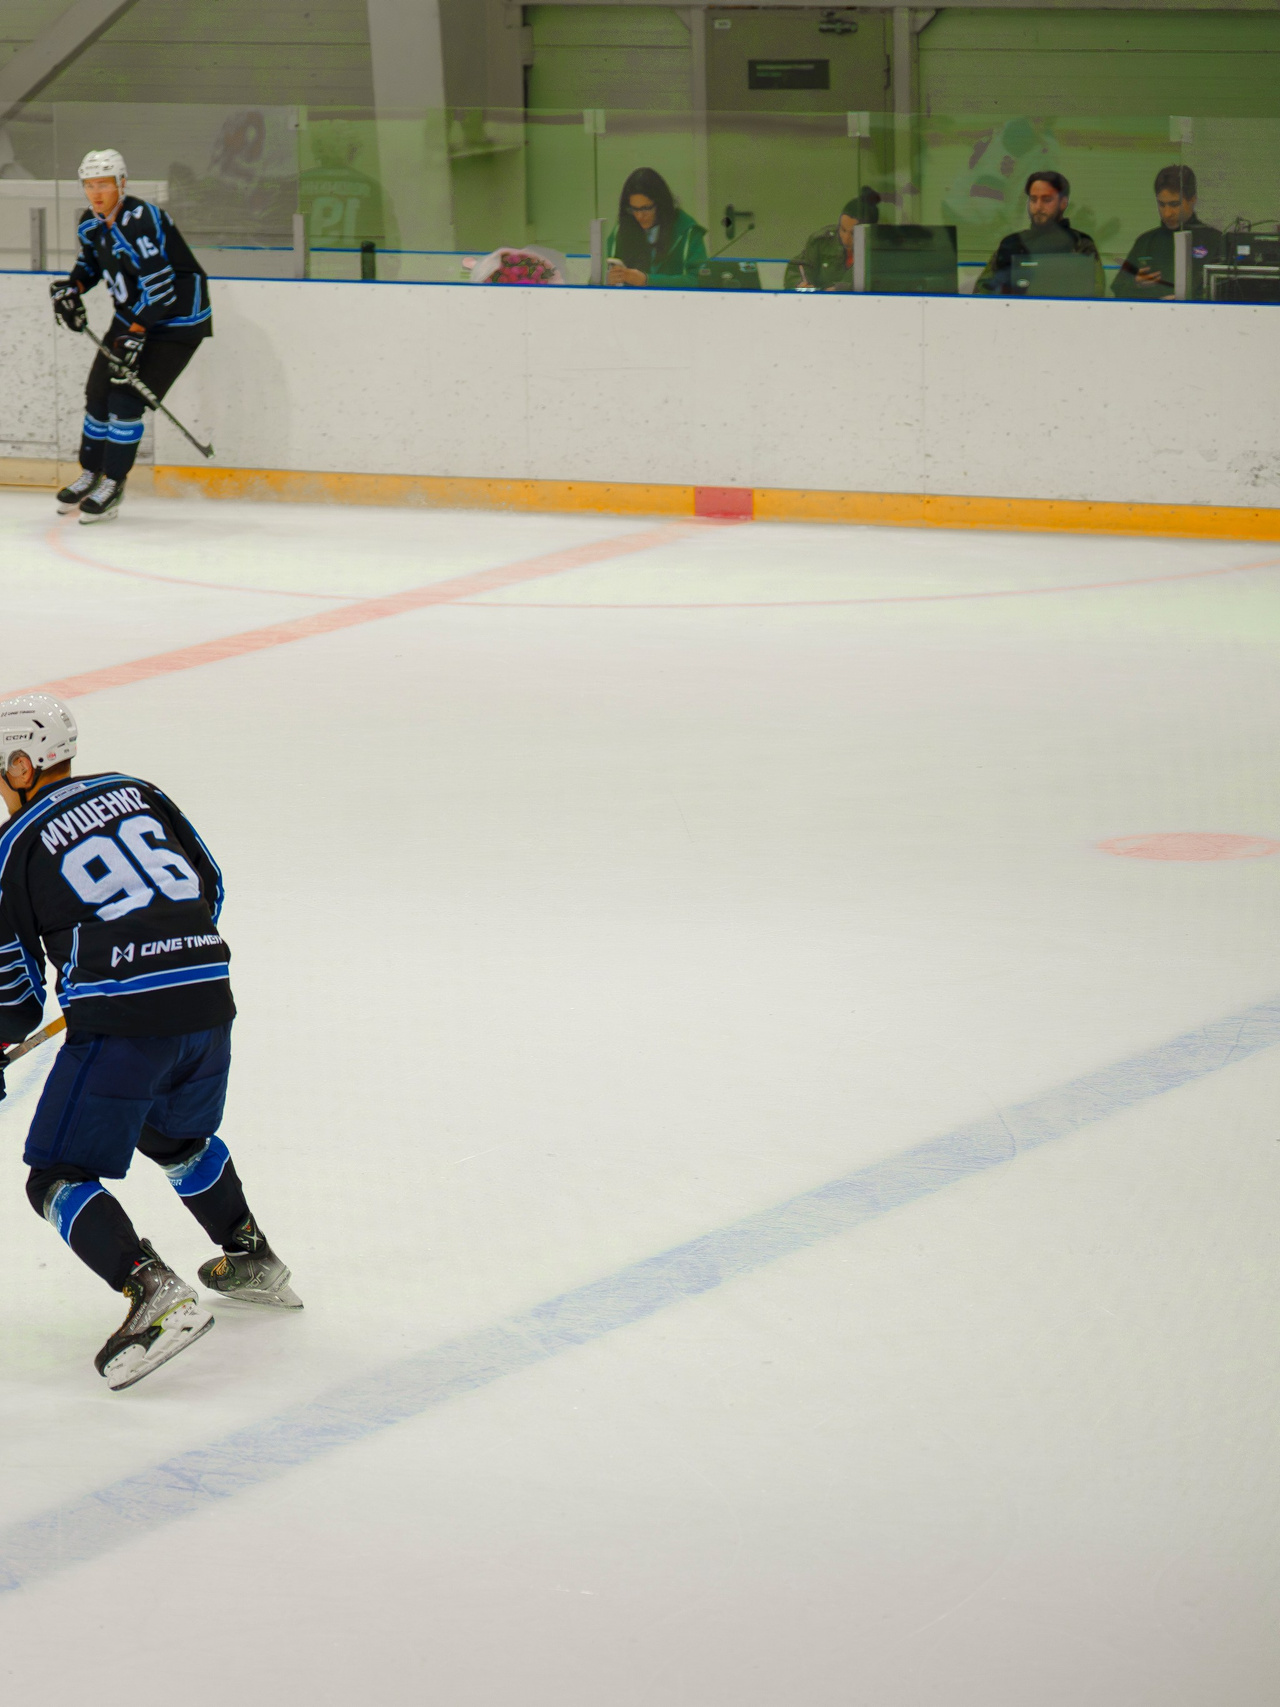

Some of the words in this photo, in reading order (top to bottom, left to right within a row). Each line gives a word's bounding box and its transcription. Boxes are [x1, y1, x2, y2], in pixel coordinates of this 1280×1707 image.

[136, 235, 159, 259] 15
[59, 815, 201, 921] 96
[141, 938, 183, 956] ONE
